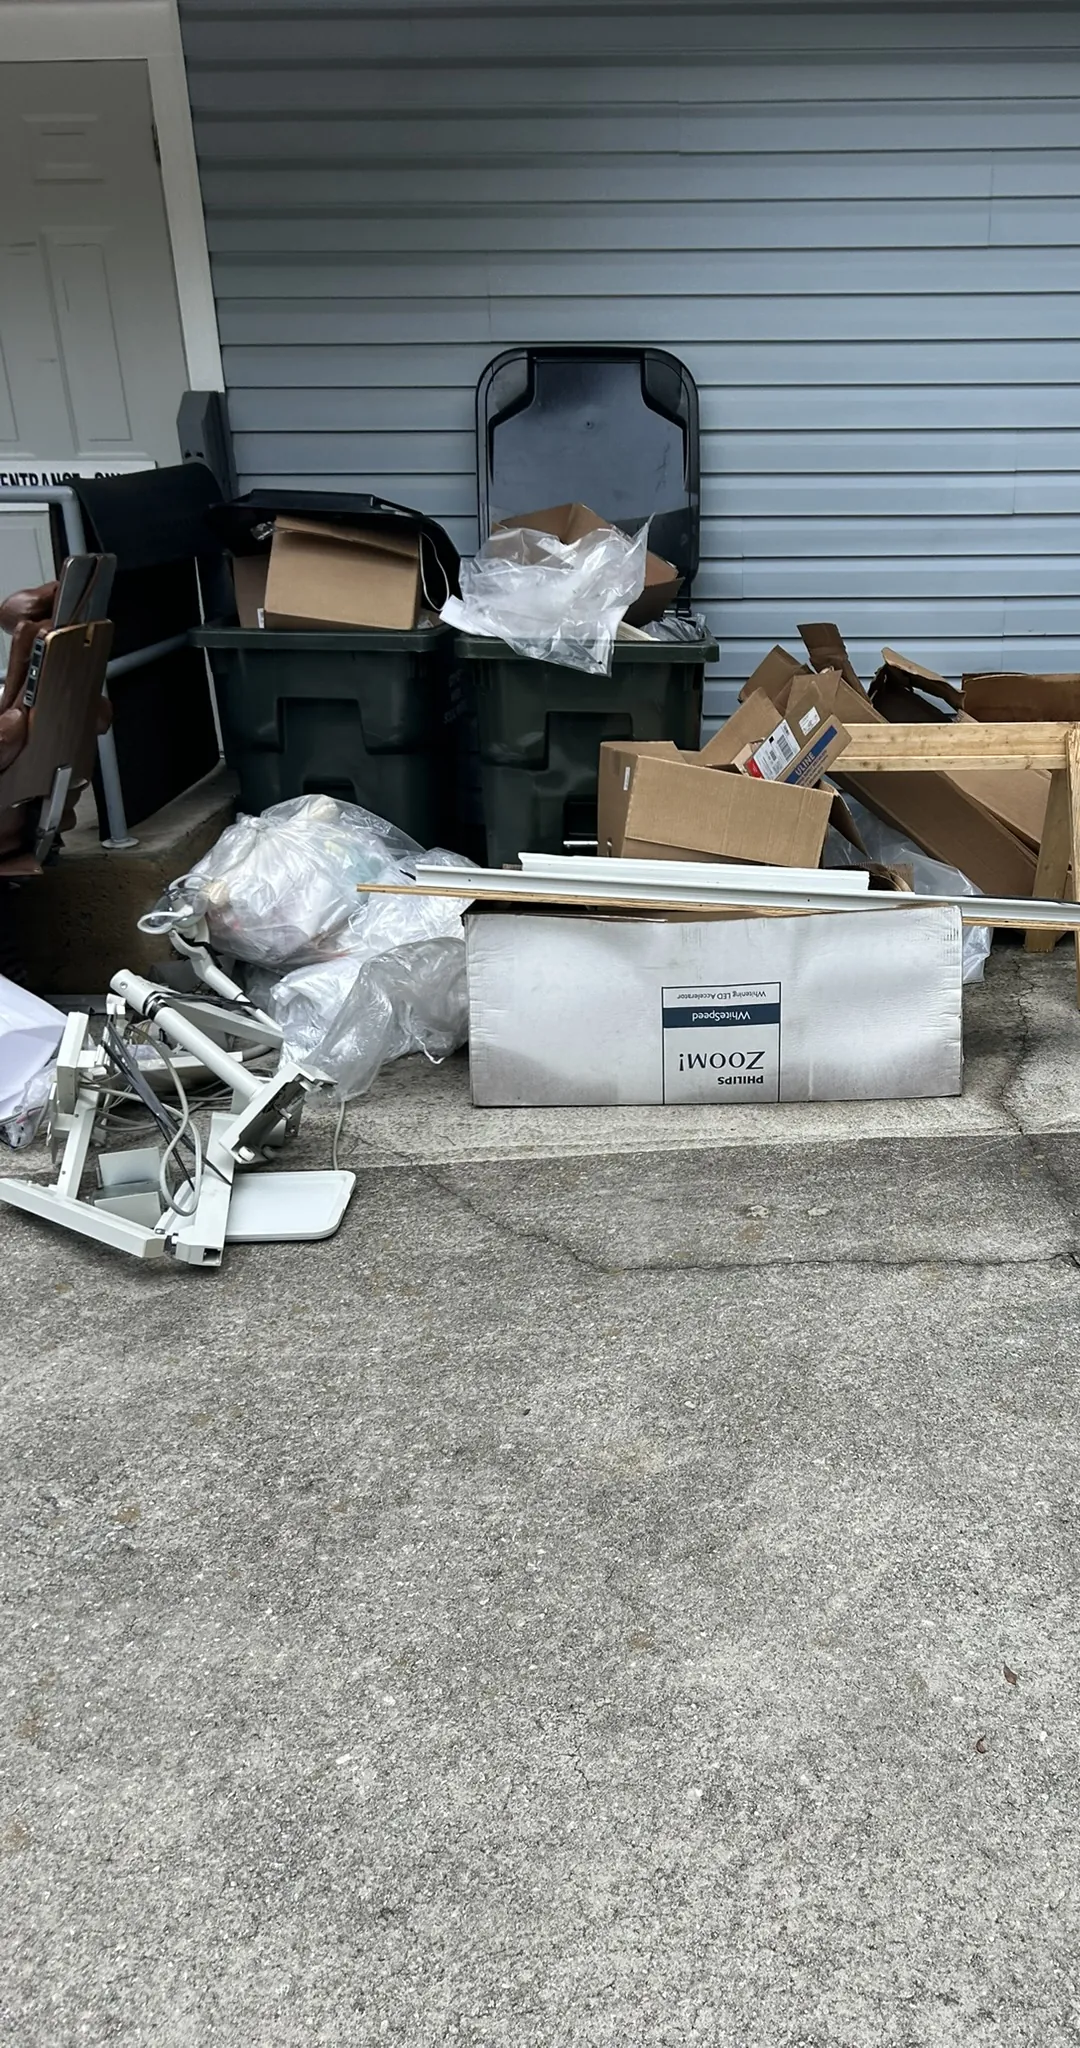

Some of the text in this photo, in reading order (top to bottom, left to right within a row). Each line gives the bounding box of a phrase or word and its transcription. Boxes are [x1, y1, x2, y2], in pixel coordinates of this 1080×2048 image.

[0, 472, 80, 487] ENTRAN
[794, 751, 816, 776] ULINE
[676, 990, 767, 1000] Whitening LED Accelerator
[691, 1009, 751, 1022] WhiteSpeed
[679, 1050, 766, 1072] ZOOM!
[717, 1075, 764, 1085] PHILIPS
